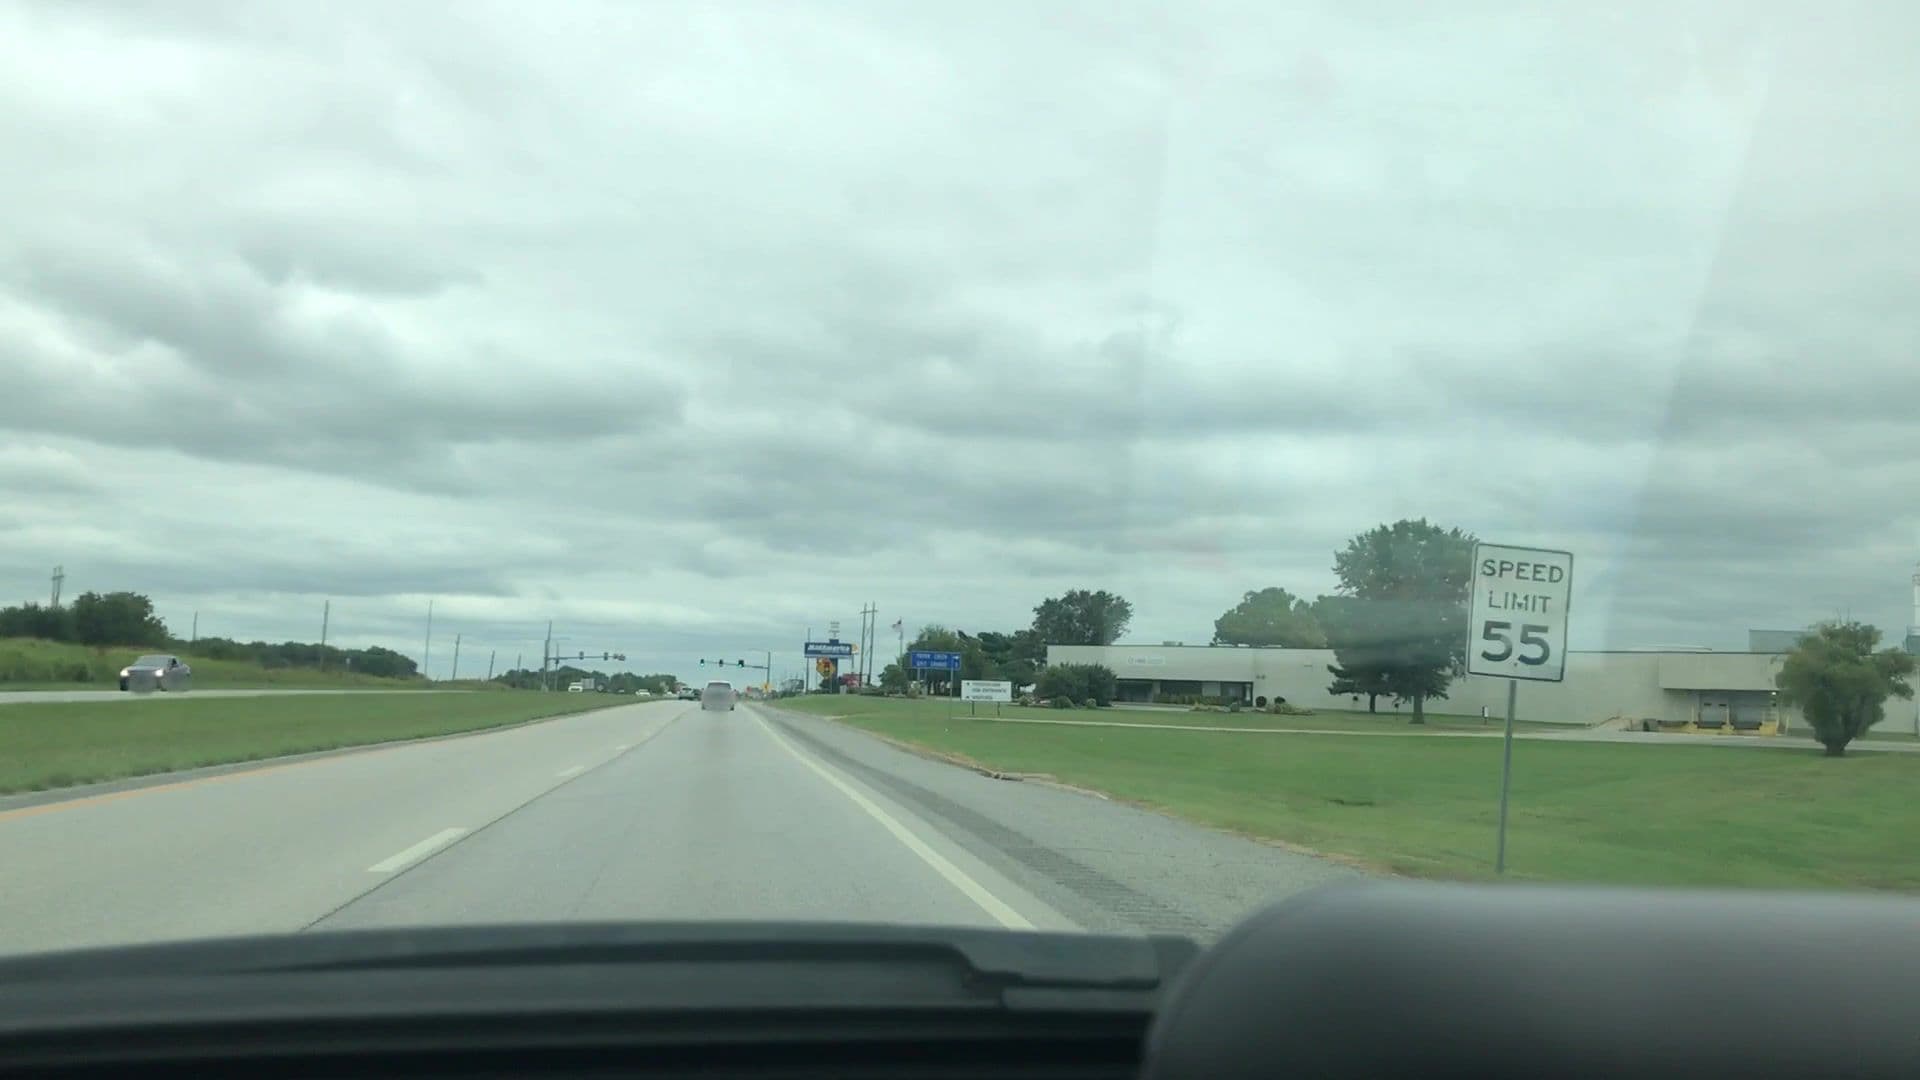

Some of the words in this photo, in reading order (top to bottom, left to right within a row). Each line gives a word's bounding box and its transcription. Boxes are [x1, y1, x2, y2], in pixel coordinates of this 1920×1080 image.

[1481, 559, 1564, 583] SPEED
[1488, 590, 1552, 613] LIMIT
[1481, 620, 1550, 666] 55
